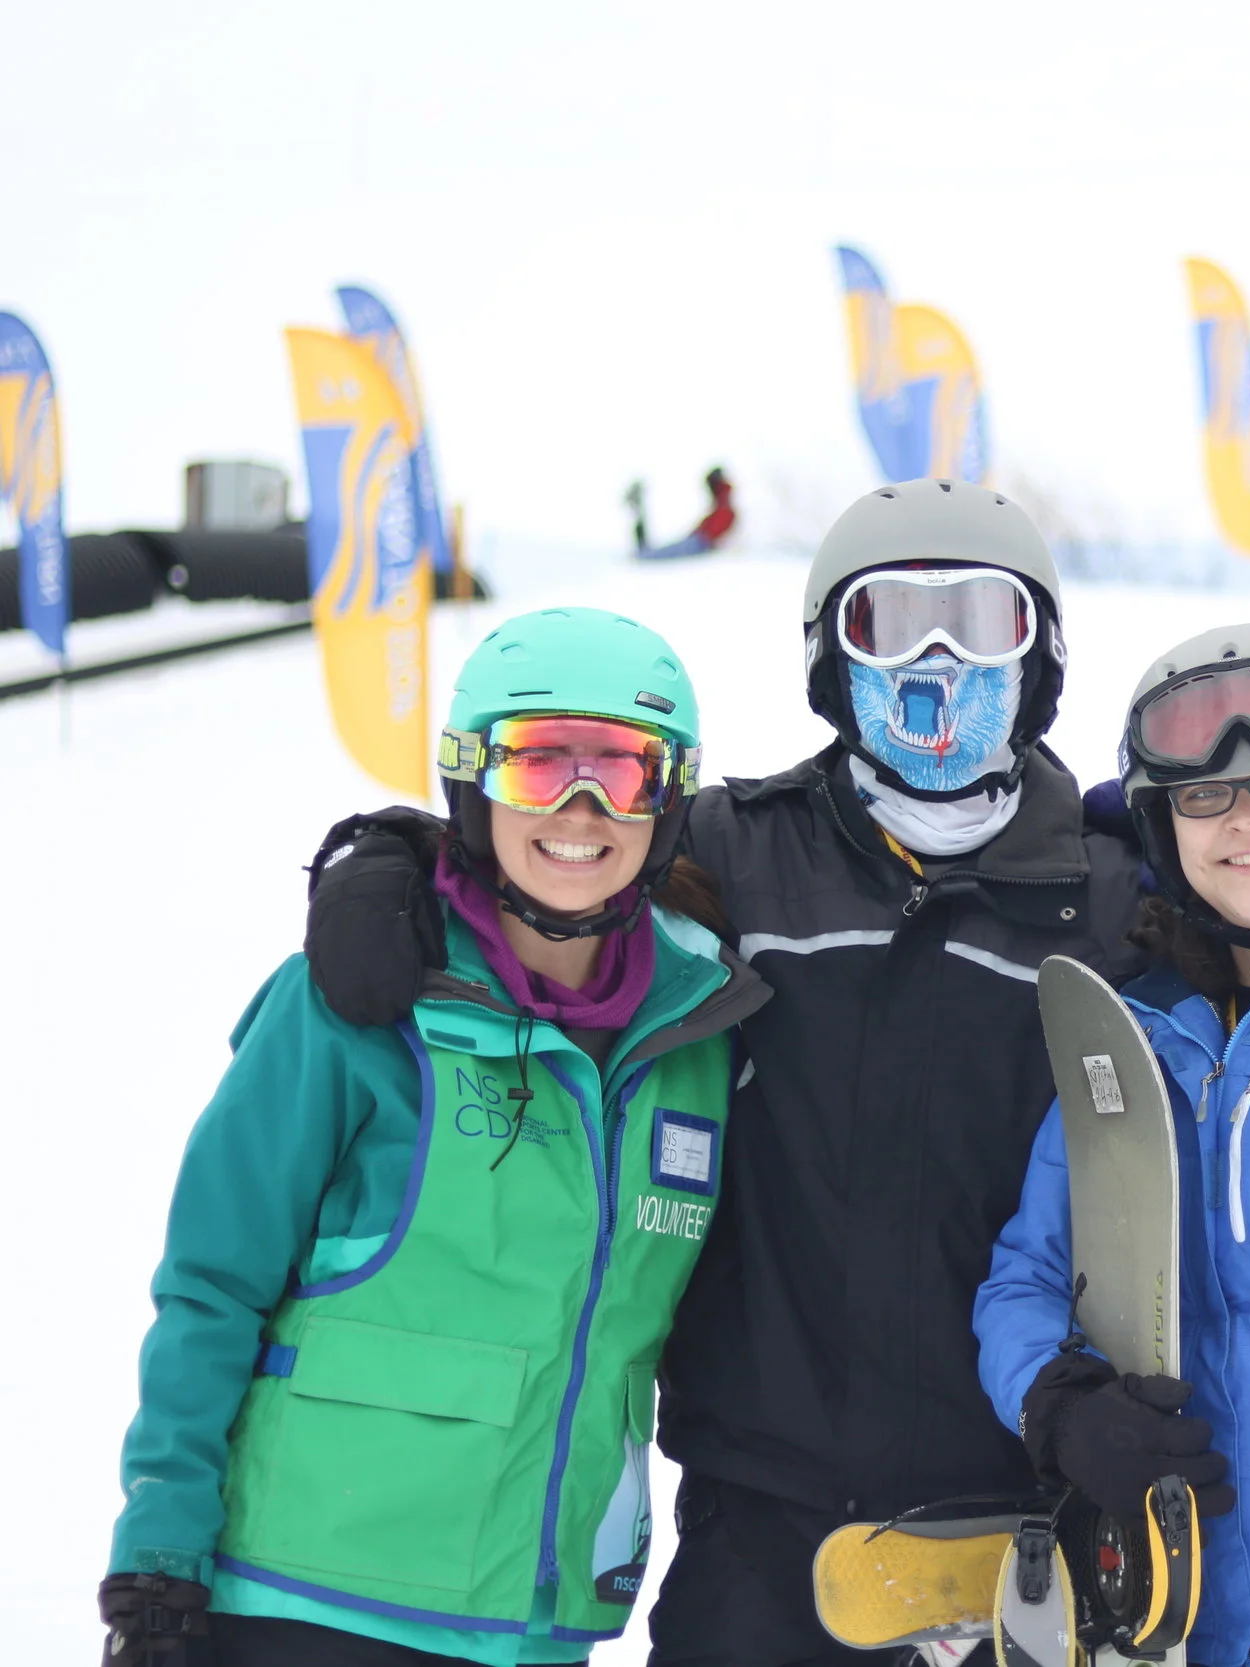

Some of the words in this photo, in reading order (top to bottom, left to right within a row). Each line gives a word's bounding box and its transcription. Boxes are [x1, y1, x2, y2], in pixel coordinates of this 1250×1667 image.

[456, 1067, 501, 1104] NS
[455, 1104, 512, 1138] CD
[663, 1130, 677, 1146] NS
[662, 1147, 678, 1163] CD
